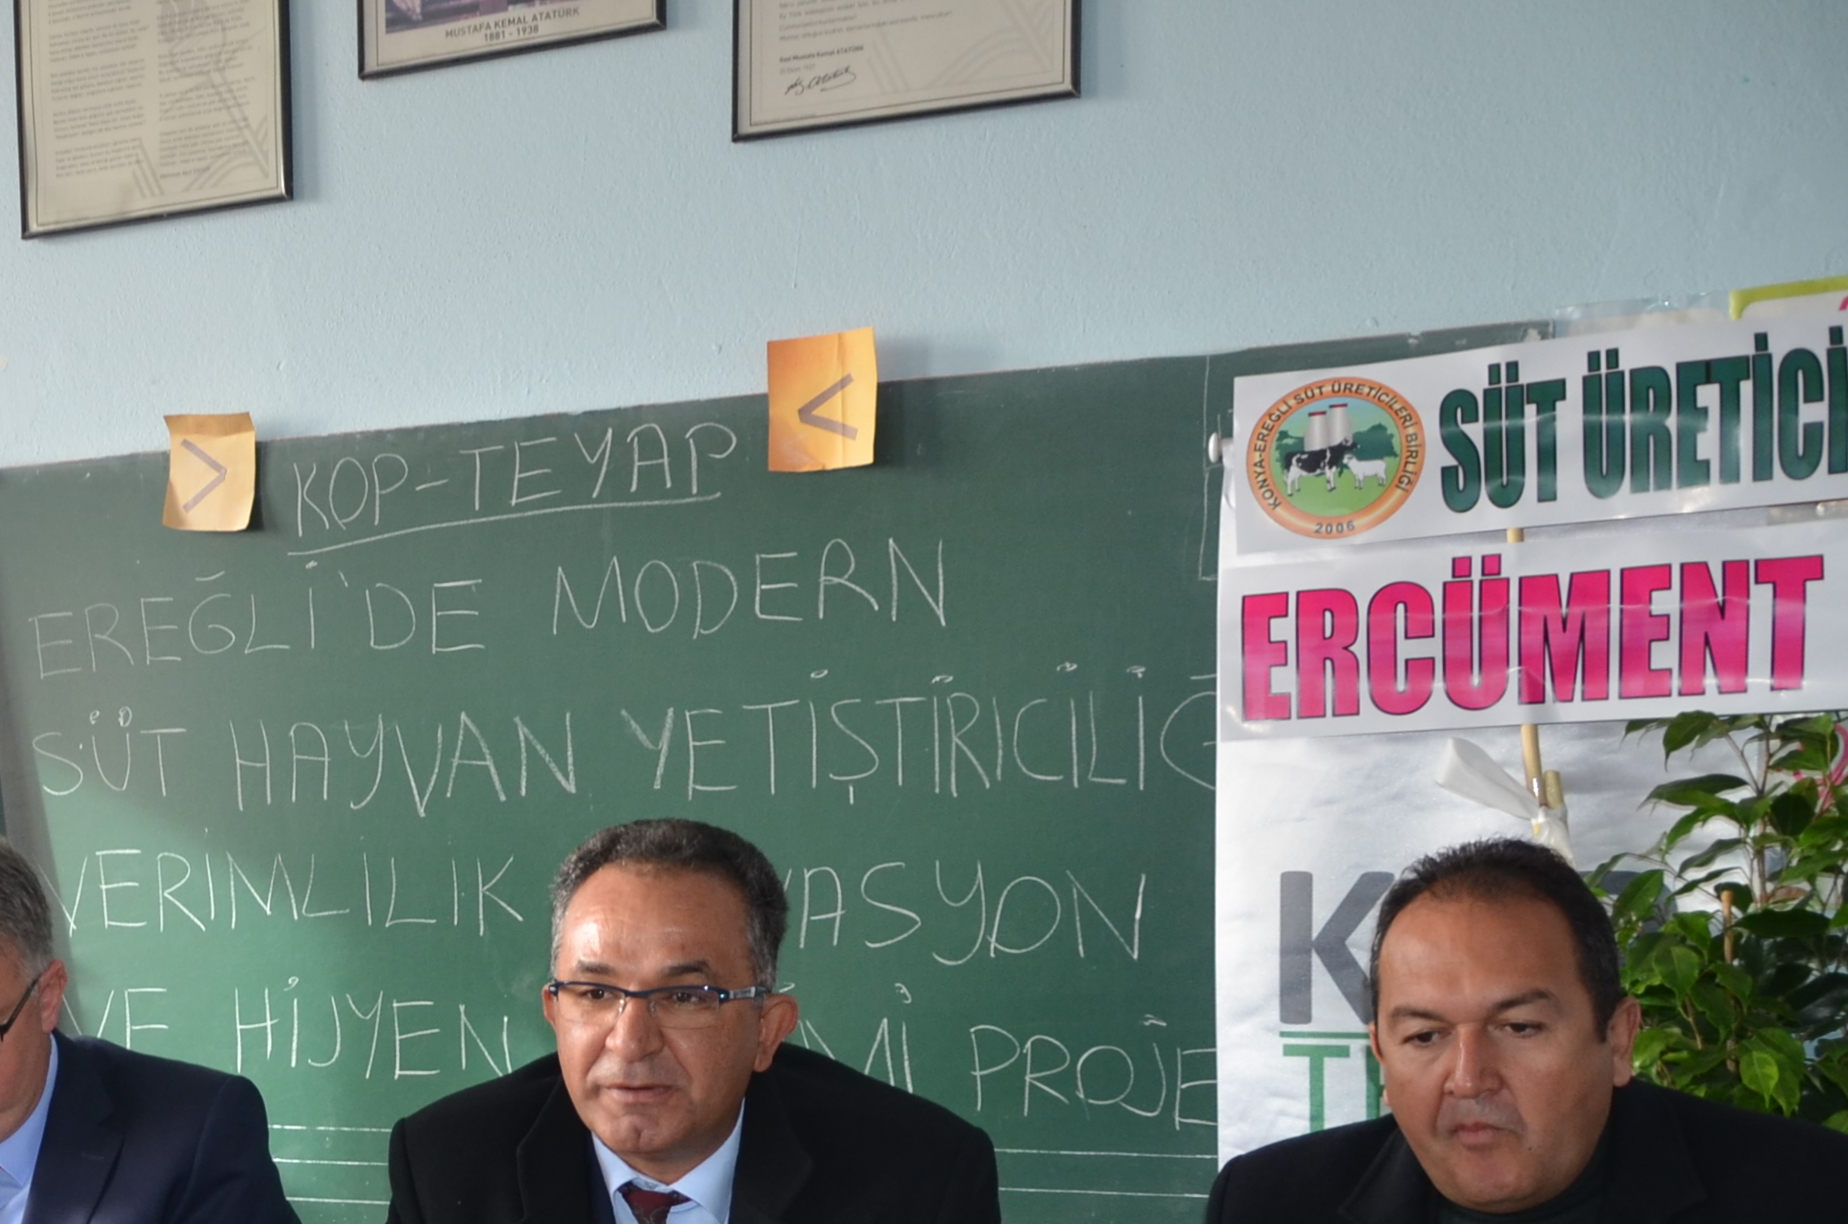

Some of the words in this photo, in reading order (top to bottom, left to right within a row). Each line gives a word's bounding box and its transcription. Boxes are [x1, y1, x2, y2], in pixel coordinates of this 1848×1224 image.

[445, 22, 491, 39] MUSTAFA
[494, 16, 529, 29] KEMAL
[484, 30, 506, 42] 1881
[516, 25, 540, 37] 1938
[1294, 384, 1326, 404] SÜT
[1439, 360, 1567, 514] SÜT
[292, 421, 737, 537] KOP-TEYAP
[1315, 520, 1356, 535] 2006
[552, 537, 947, 637] MODERN
[1240, 552, 1826, 723] ERCÜMENT
[31, 705, 186, 798] SÜT
[229, 710, 577, 818] HAYVAN
[235, 976, 514, 1081] HİJYEN
